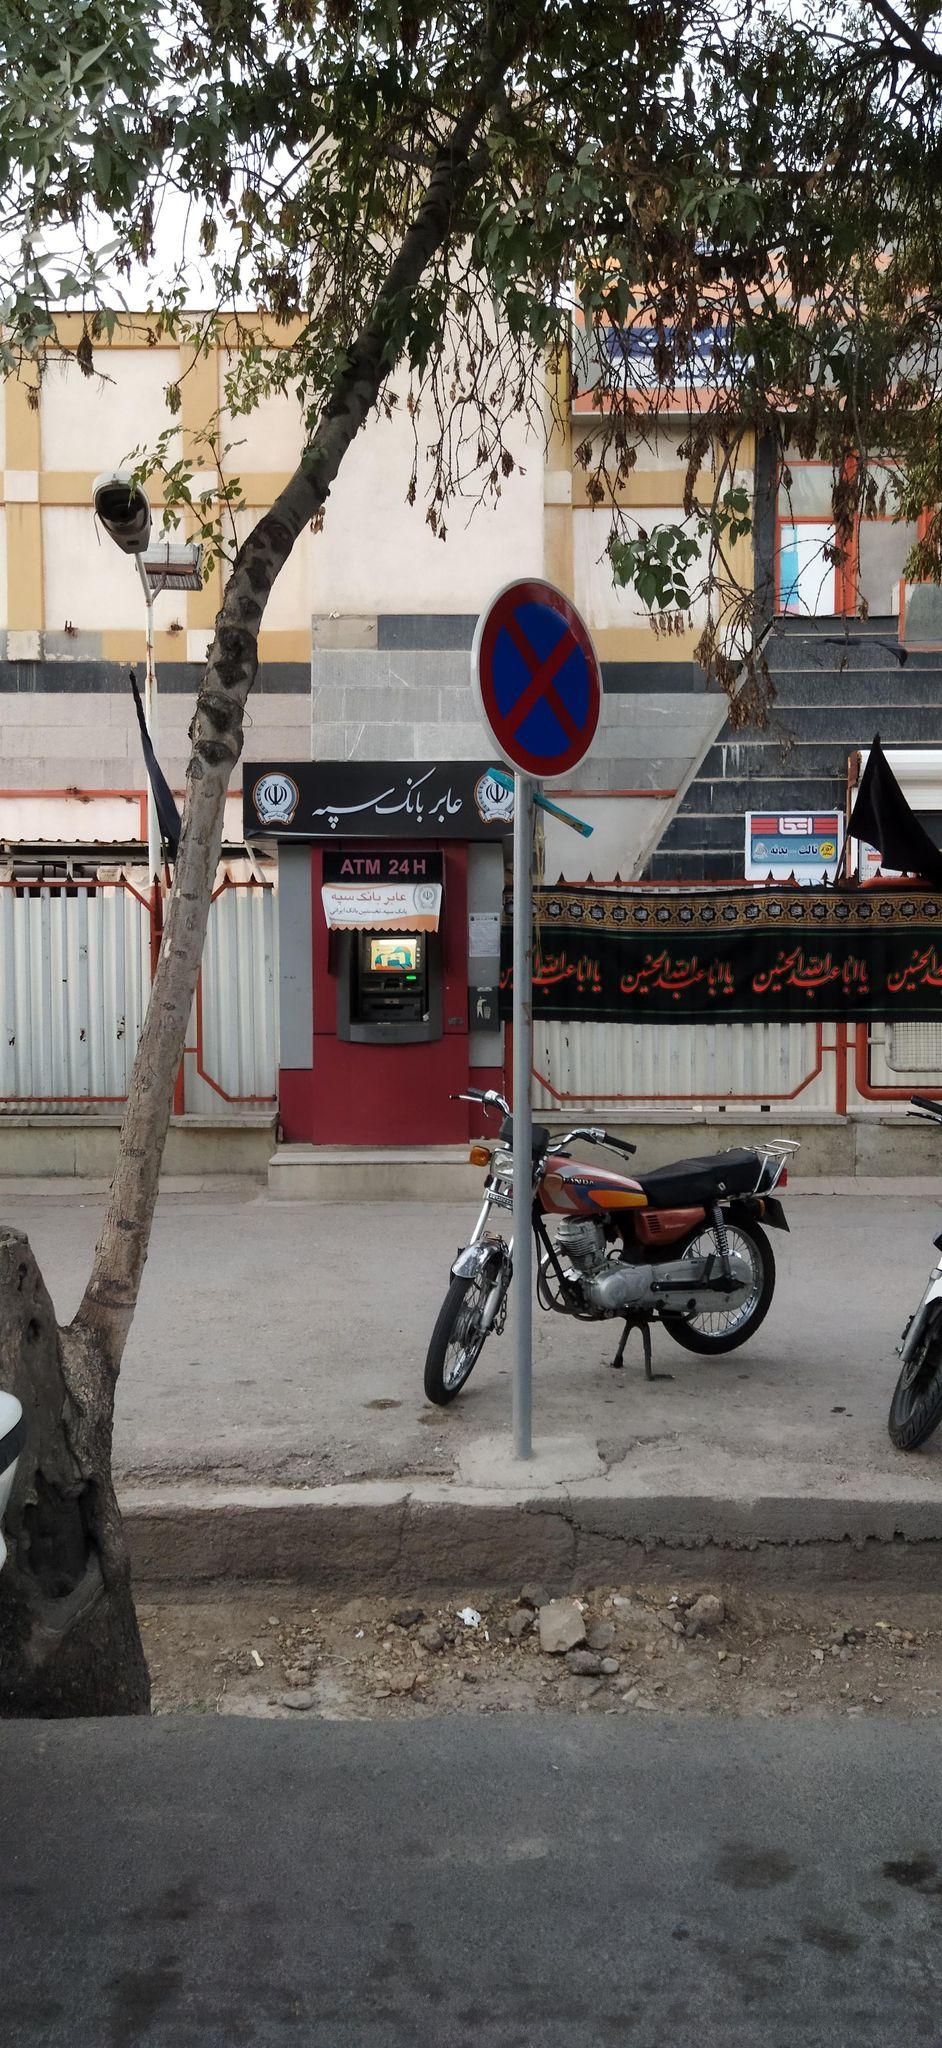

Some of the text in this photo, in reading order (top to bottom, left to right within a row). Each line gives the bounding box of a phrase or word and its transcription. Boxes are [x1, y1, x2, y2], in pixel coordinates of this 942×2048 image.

[311, 766, 464, 830] عابر بانک سپه
[340, 859, 381, 875] ATM
[332, 891, 407, 906] عابر بانک سپه
